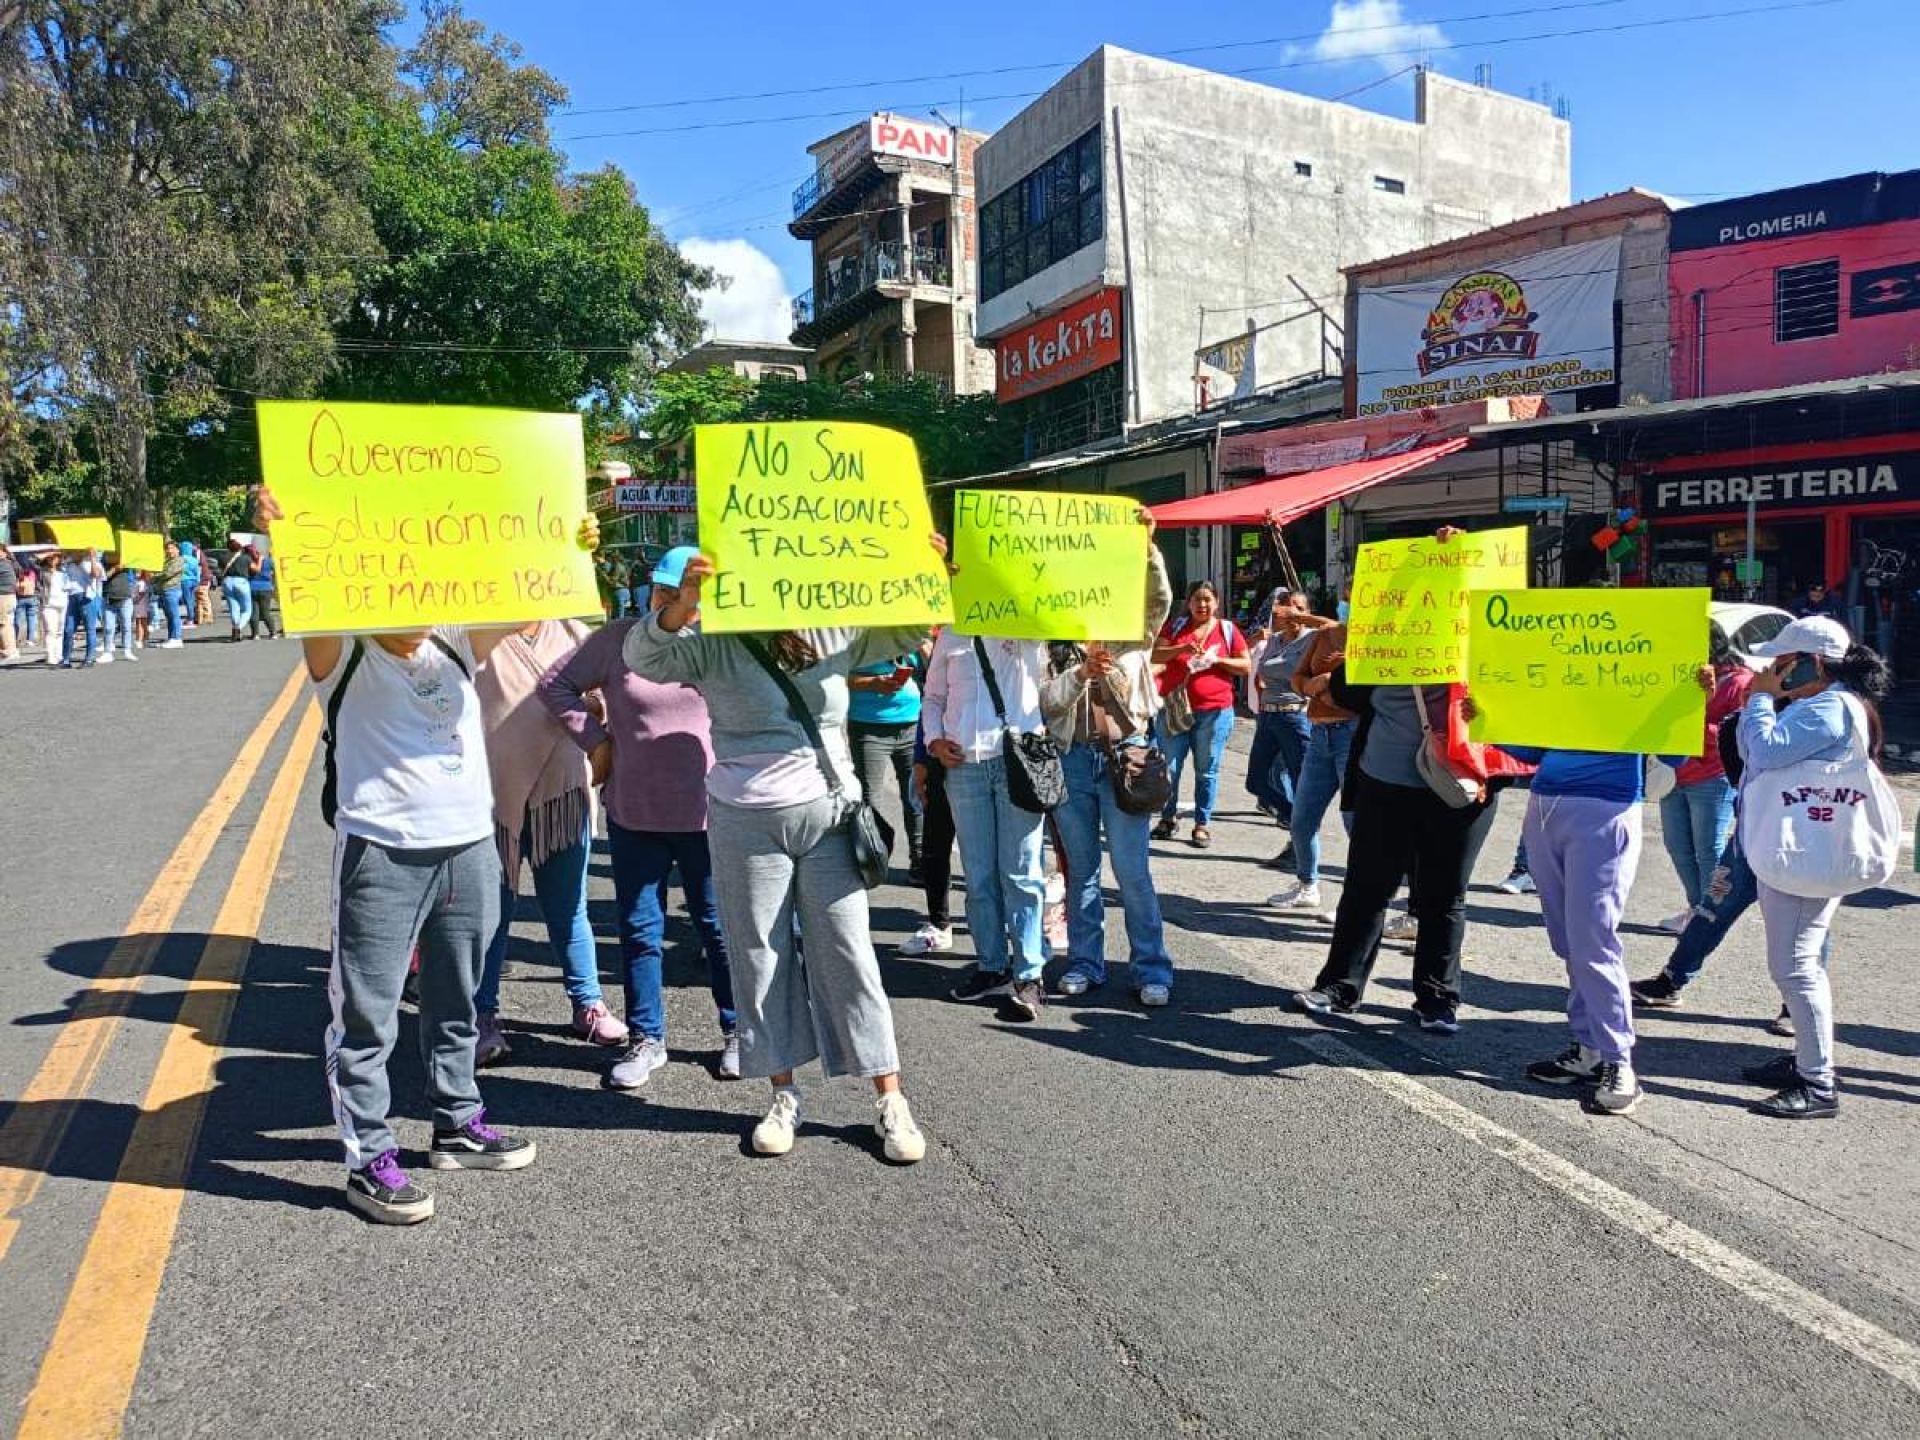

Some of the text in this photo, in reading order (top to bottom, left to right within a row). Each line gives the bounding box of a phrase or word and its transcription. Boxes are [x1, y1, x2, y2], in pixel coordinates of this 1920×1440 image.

[877, 124, 948, 158] PAN
[1719, 210, 1828, 243] PLOMERIA
[1429, 335, 1524, 364] SINAI
[1382, 359, 1582, 400] DONDE LA CALIDAD
[1359, 402, 1389, 416] NO
[1391, 394, 1447, 413] TIENE
[308, 408, 502, 478] Queremos
[621, 488, 651, 502] AGUA
[1657, 464, 1899, 508] FERRETERIA
[537, 495, 565, 540] la
[720, 484, 910, 530] ACUSACIONES
[958, 491, 1047, 529] FUERA
[1055, 497, 1080, 527] LA
[740, 527, 889, 559] FALSAS
[988, 532, 1097, 560] MAXIMINA
[1408, 543, 1485, 568] SANCHEZ
[279, 552, 418, 582] ESCUELA
[1031, 561, 1046, 583] Y
[290, 568, 579, 622] 5 DE MAYO DE 1862
[714, 570, 755, 610] EL
[773, 578, 873, 611] PUEBLO
[964, 599, 1019, 625] ANA
[1034, 585, 1111, 615] MARIA!!
[1422, 589, 1437, 609] A
[1486, 594, 1617, 631] Queremos
[1416, 647, 1435, 659] ES
[1551, 631, 1652, 656] Solución
[1376, 666, 1398, 678] DE
[1478, 663, 1516, 684] Esc
[1526, 663, 1547, 688] 5
[1562, 666, 1589, 687] de
[1597, 663, 1661, 698] Mayo
[1807, 806, 1834, 822] 92
